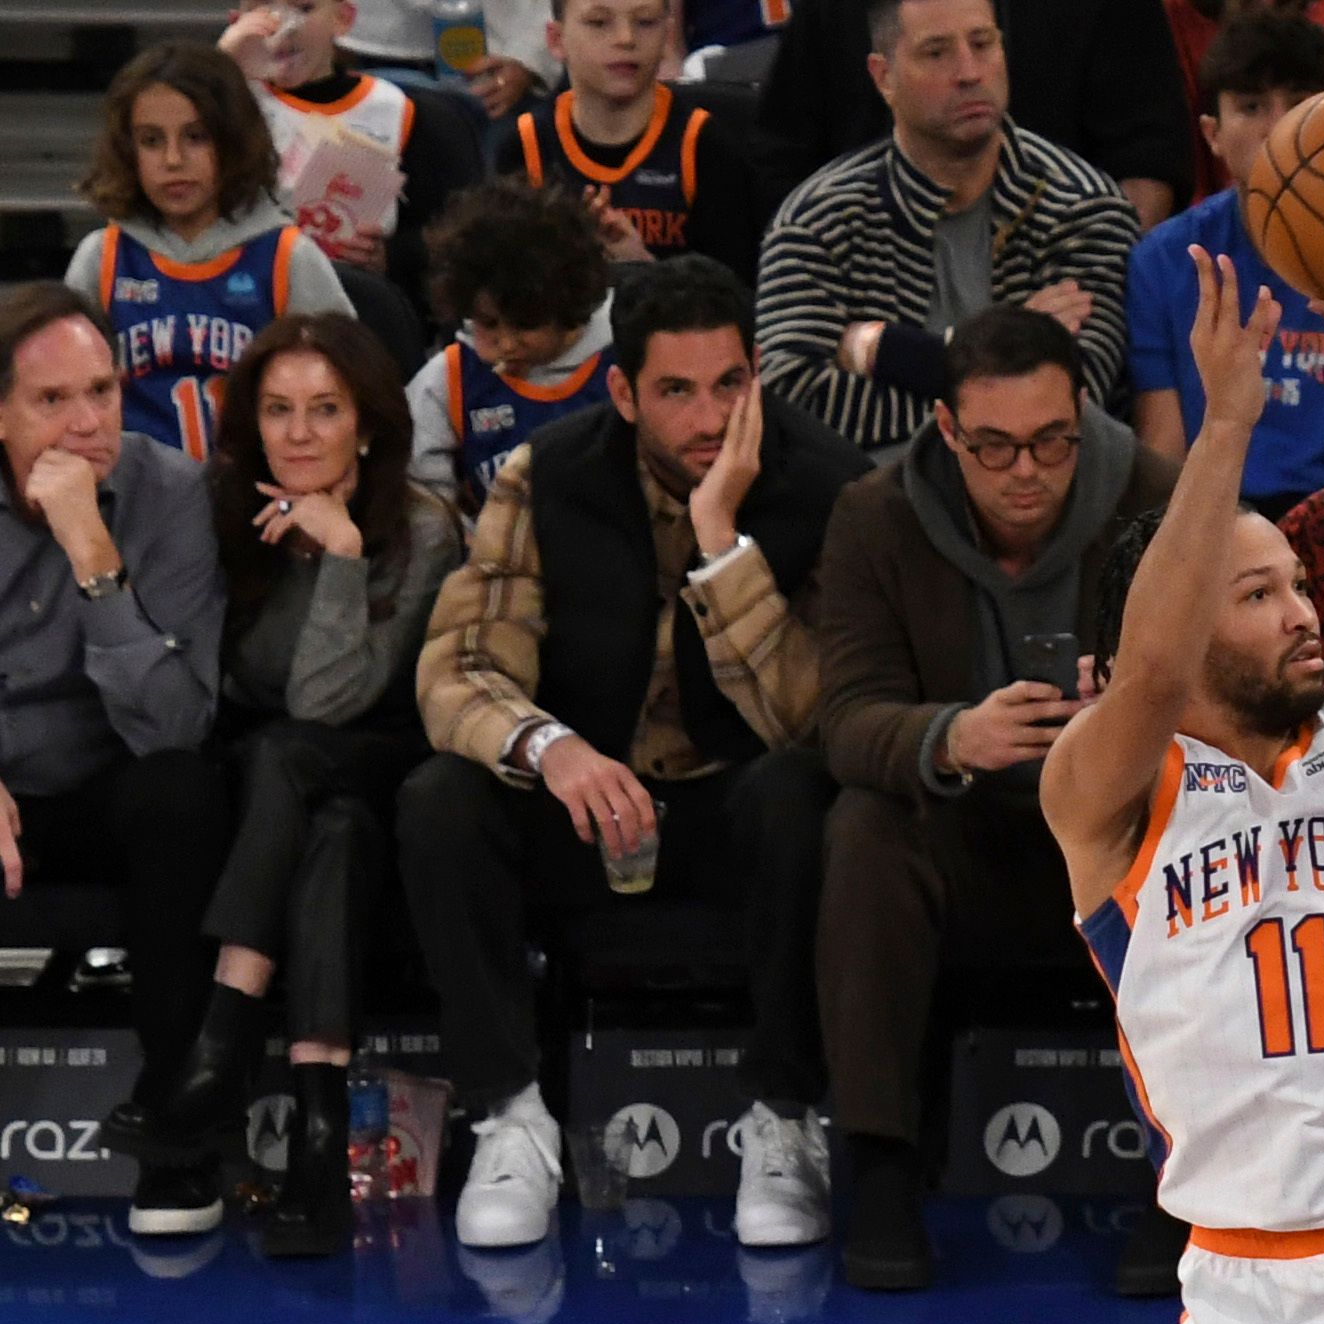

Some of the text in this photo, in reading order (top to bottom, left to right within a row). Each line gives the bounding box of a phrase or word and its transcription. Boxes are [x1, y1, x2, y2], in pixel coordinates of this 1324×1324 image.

[117, 312, 254, 376] EW YOR
[1185, 762, 1246, 793] NYC
[1163, 826, 1261, 938] NEW
[1, 1120, 110, 1159] raz
[1082, 1120, 1146, 1159] ra
